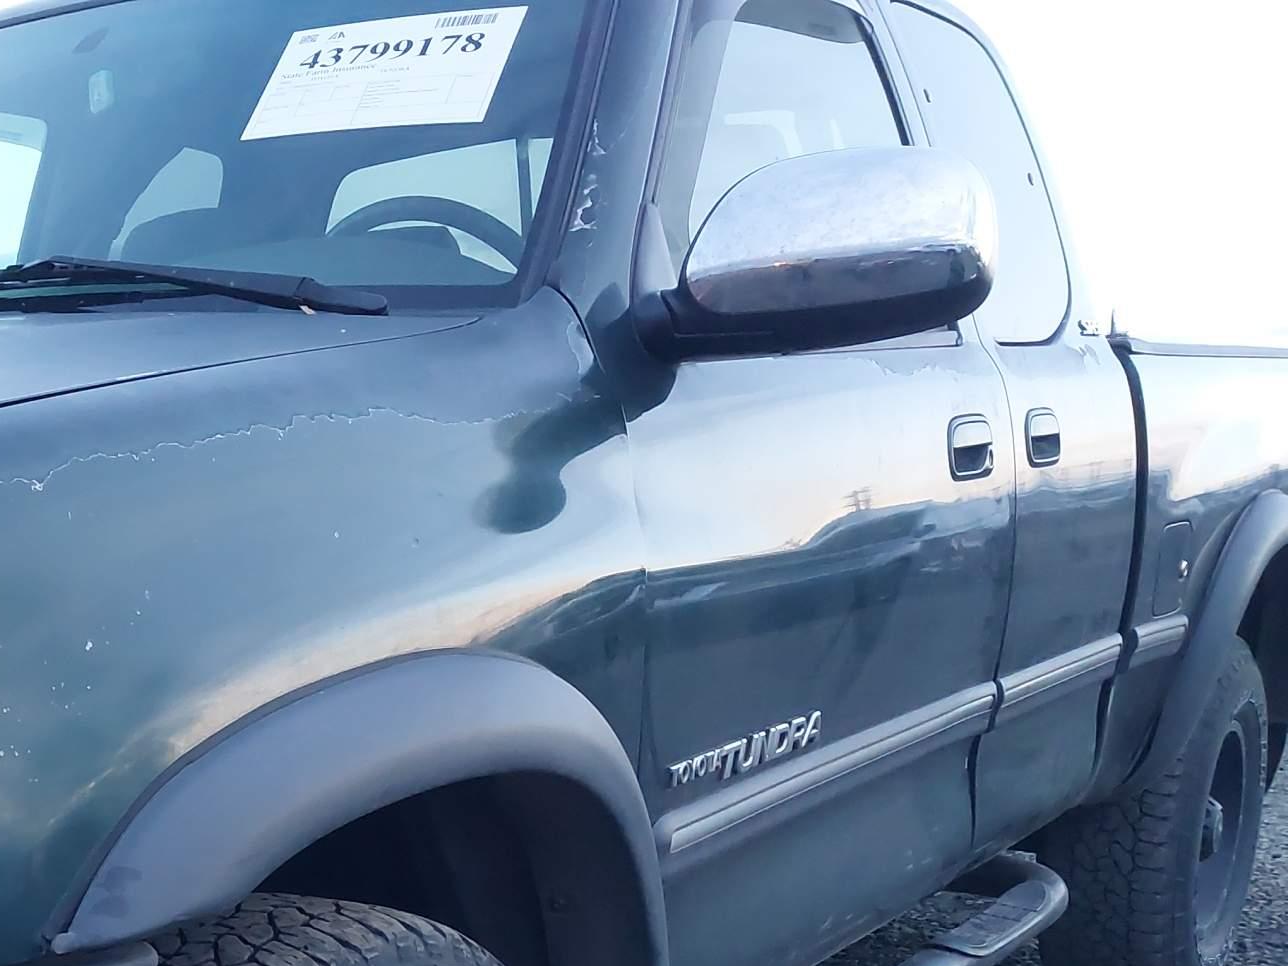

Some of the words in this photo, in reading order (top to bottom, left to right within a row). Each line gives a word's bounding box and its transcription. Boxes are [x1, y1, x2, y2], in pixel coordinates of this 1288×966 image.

[299, 32, 486, 69] 43799178
[669, 749, 722, 787] TOYOTA
[721, 711, 822, 780] TUNDRA
